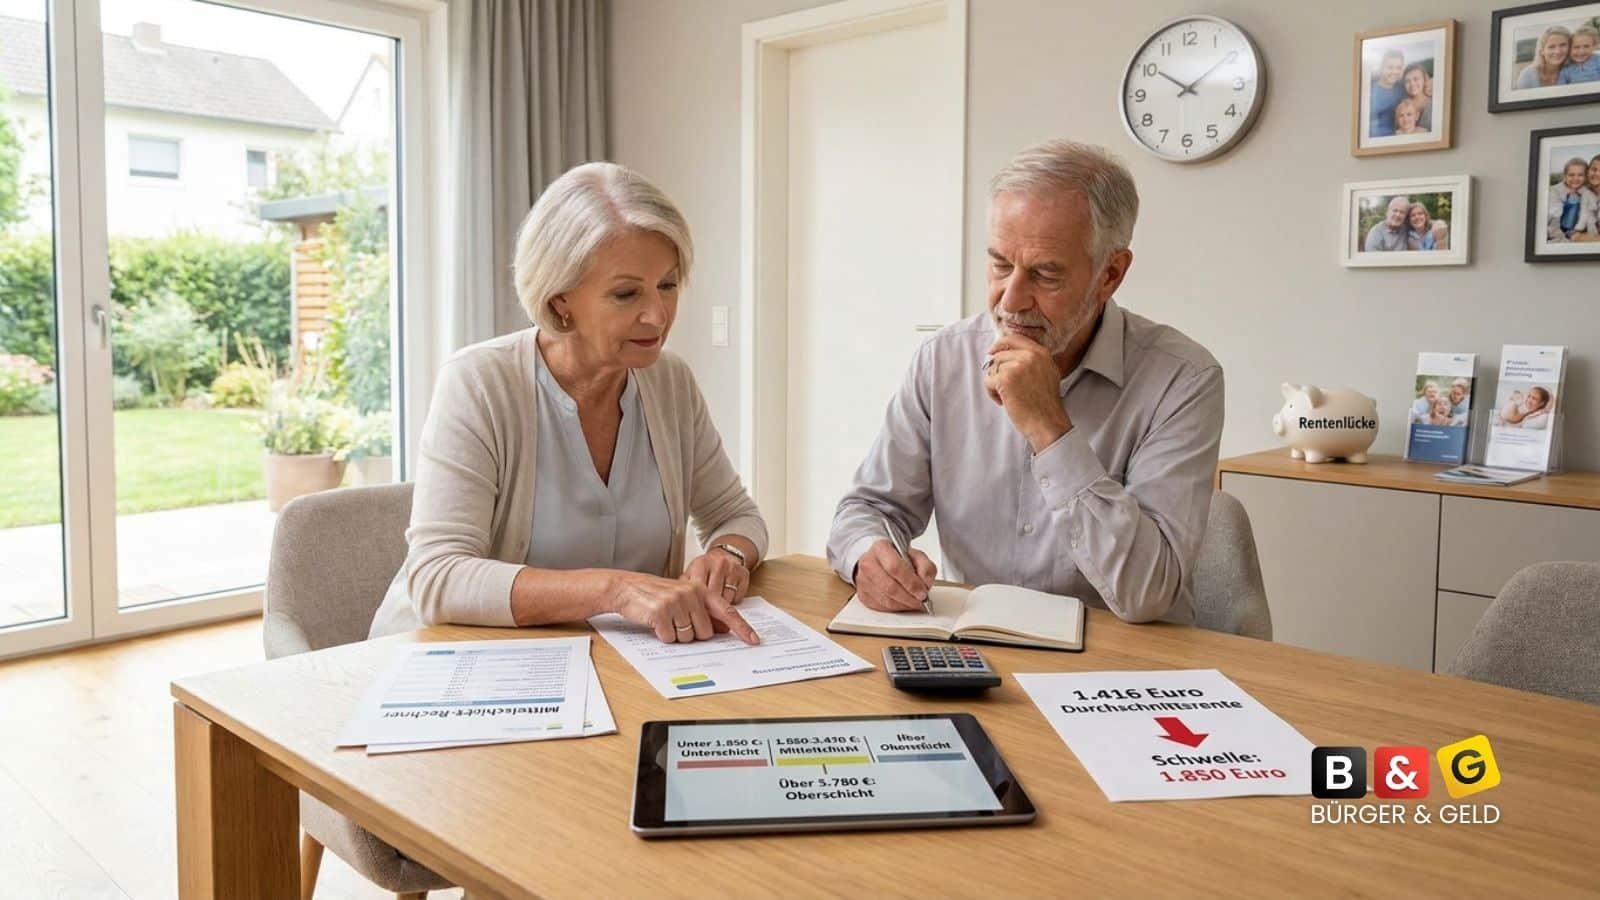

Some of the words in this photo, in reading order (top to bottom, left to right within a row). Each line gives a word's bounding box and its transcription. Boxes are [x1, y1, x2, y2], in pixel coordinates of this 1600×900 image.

[1183, 31, 1198, 46] 12
[1161, 43, 1171, 56] 11
[1143, 63, 1158, 77] 10
[1233, 77, 1246, 92] 3
[1135, 89, 1147, 103] 9
[1224, 104, 1237, 118] 4
[1141, 113, 1154, 127] 8
[1159, 129, 1169, 144] 7
[1206, 125, 1219, 139] 5
[1181, 134, 1193, 148] 6
[1299, 416, 1376, 429] Rentenlücke
[1073, 689, 1142, 701] 1.416
[1146, 688, 1204, 699] Euro
[677, 740, 711, 748] Unter
[716, 739, 748, 747] 1.850
[681, 748, 760, 757] Unterschicht
[1152, 752, 1262, 767] Schwelle:
[1160, 769, 1227, 783] 1.850
[1229, 768, 1287, 780] Euro
[779, 778, 813, 789] Über
[818, 778, 859, 788] 5.780
[785, 789, 875, 800] Oberschicht
